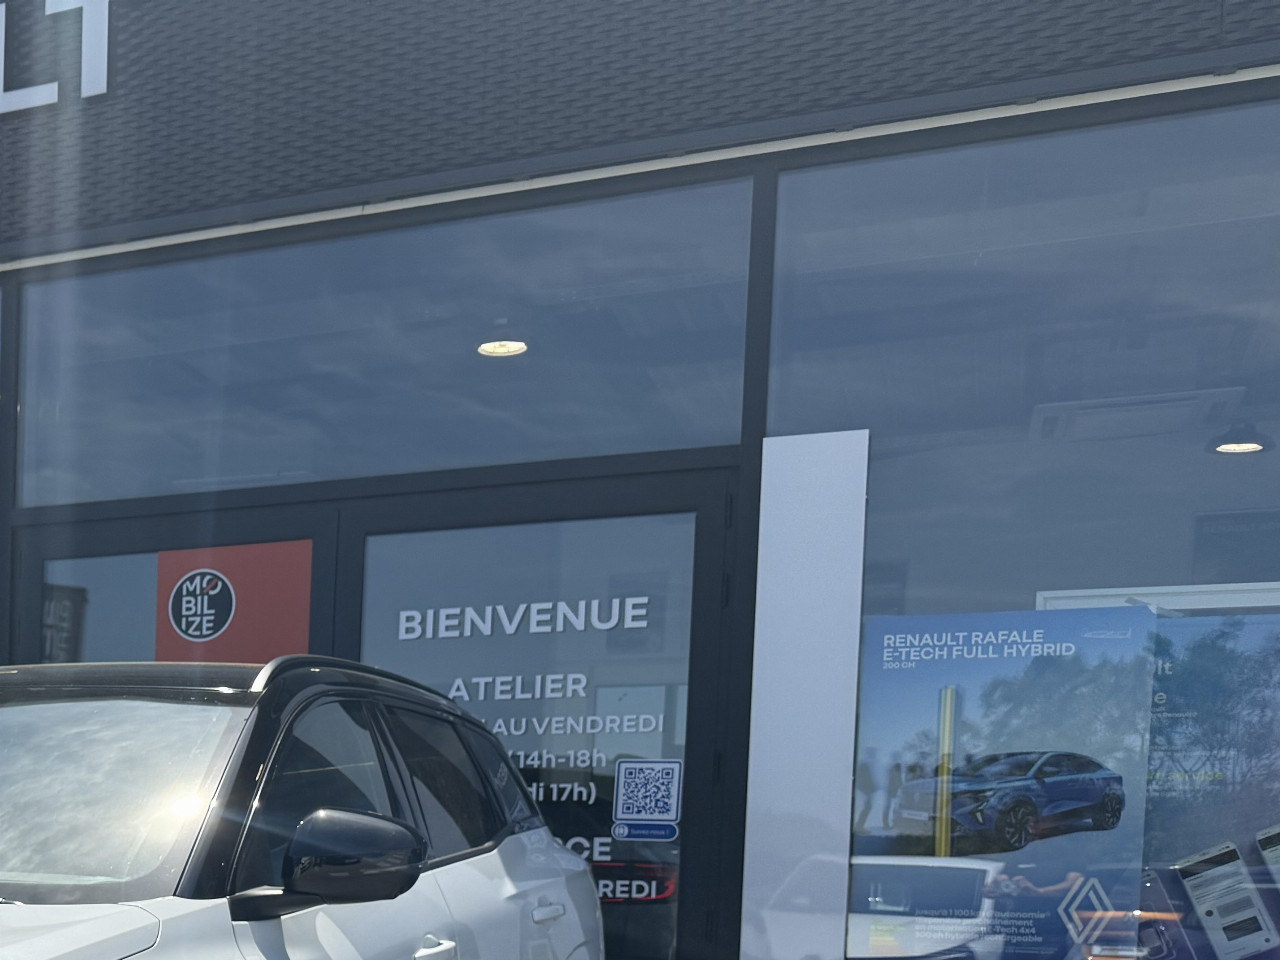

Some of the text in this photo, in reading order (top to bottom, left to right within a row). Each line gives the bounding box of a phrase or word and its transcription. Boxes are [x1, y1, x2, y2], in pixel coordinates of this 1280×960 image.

[181, 595, 215, 615] BIL
[181, 614, 214, 635] IZE
[398, 597, 649, 640] BIENVENUE
[884, 629, 1044, 647] RENAULT RAFALE
[883, 643, 1076, 661] E-TECH FULL HYBRID
[448, 673, 588, 701] ATELIER
[492, 714, 664, 735] AU VENDREDI
[517, 749, 607, 769] 14h-18h
[549, 781, 597, 805] 17h)
